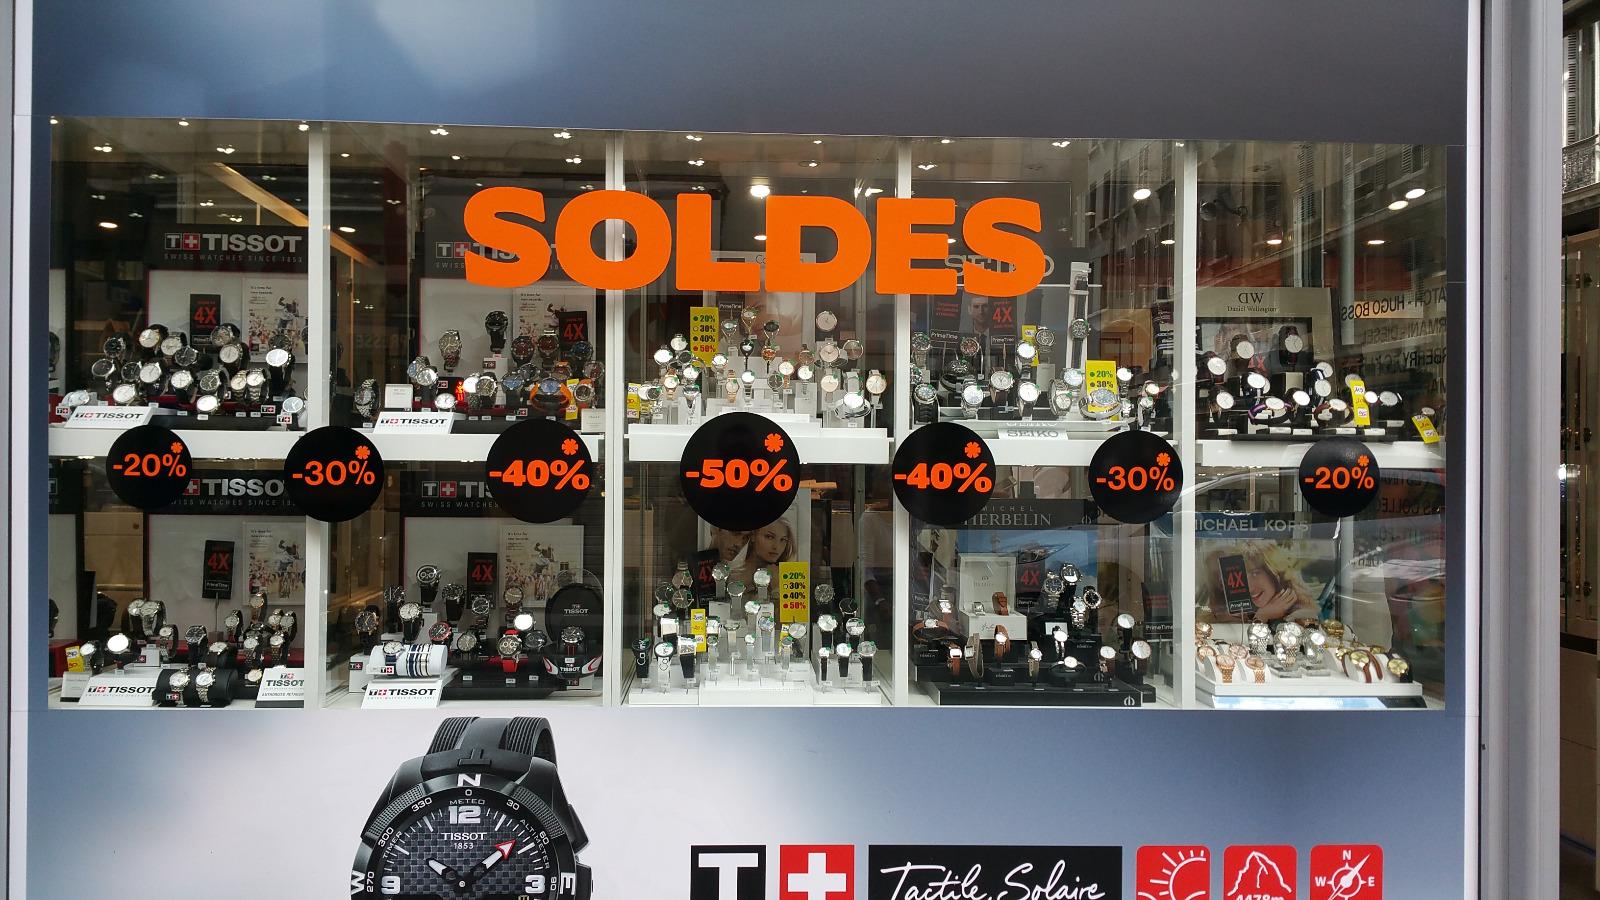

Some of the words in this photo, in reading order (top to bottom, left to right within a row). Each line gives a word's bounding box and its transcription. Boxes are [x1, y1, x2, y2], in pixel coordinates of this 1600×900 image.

[202, 233, 302, 252] TISSOT
[464, 186, 1046, 297] SOLDES
[992, 306, 1013, 323] 4X
[1007, 429, 1059, 438] SEIKO
[202, 478, 285, 497] TISSO
[1195, 519, 1258, 531] ICHAEL
[789, 572, 806, 580] 20%
[789, 582, 806, 590] 30%
[789, 592, 806, 600] 40%
[789, 602, 806, 610] 50%
[107, 686, 155, 694] TISSOT
[388, 688, 436, 696] TISSOT
[457, 773, 481, 787] N
[411, 797, 433, 812] 330
[506, 799, 520, 811] 30
[449, 805, 481, 824] 12
[378, 826, 394, 848] 300
[441, 832, 487, 841] TISSOT
[539, 831, 550, 846] 60
[453, 842, 474, 850] 1853
[1343, 850, 1351, 860] N
[366, 871, 375, 893] 270
[381, 875, 401, 895] 9
[525, 874, 546, 894] 3
